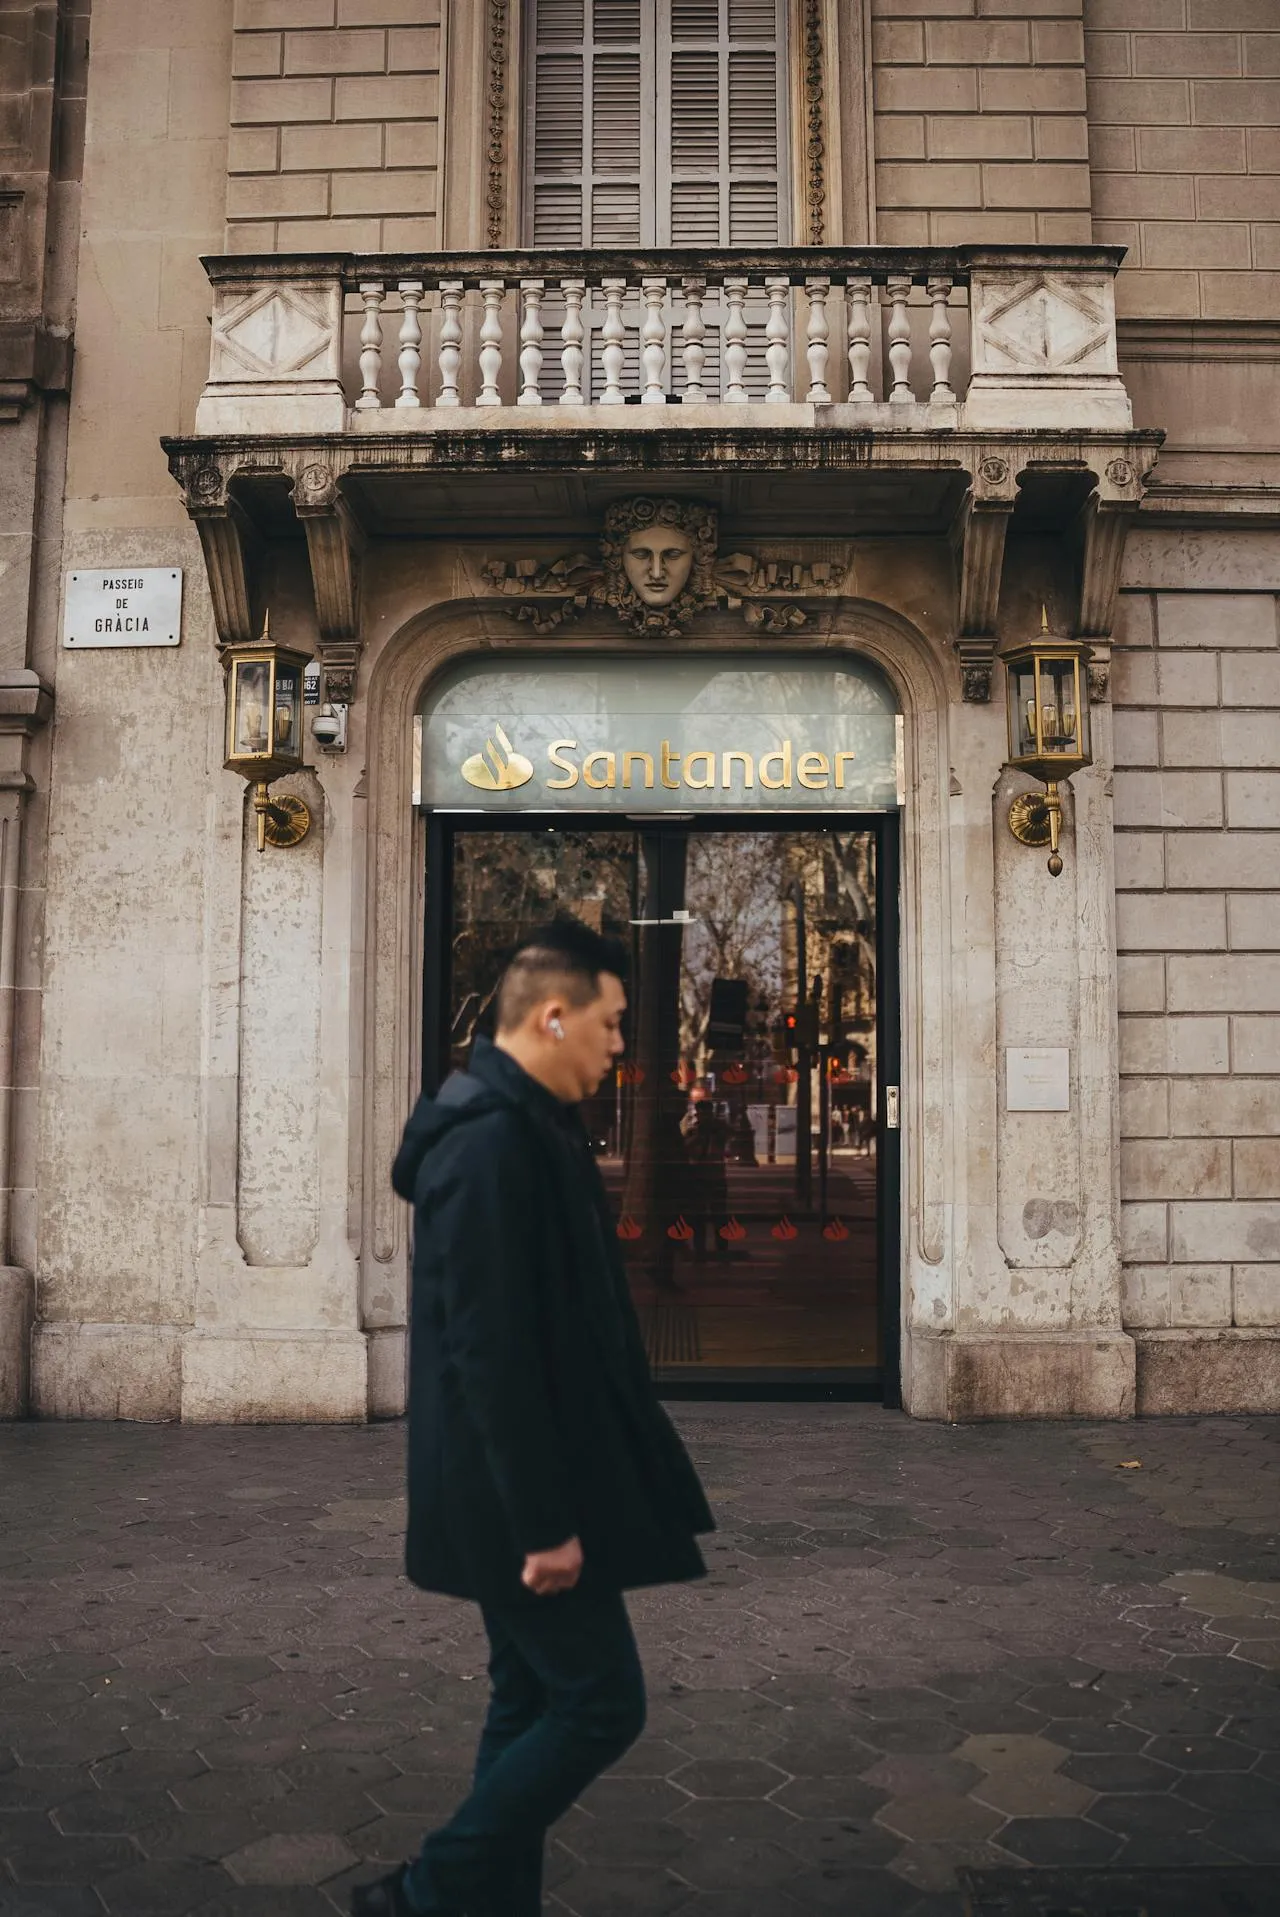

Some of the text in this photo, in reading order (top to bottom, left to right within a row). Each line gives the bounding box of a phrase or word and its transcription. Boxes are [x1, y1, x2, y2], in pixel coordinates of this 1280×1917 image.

[102, 579, 144, 590] PASSEIG
[116, 598, 128, 609] DE
[95, 613, 149, 632] GRÀCIA
[545, 739, 855, 790] Santander
